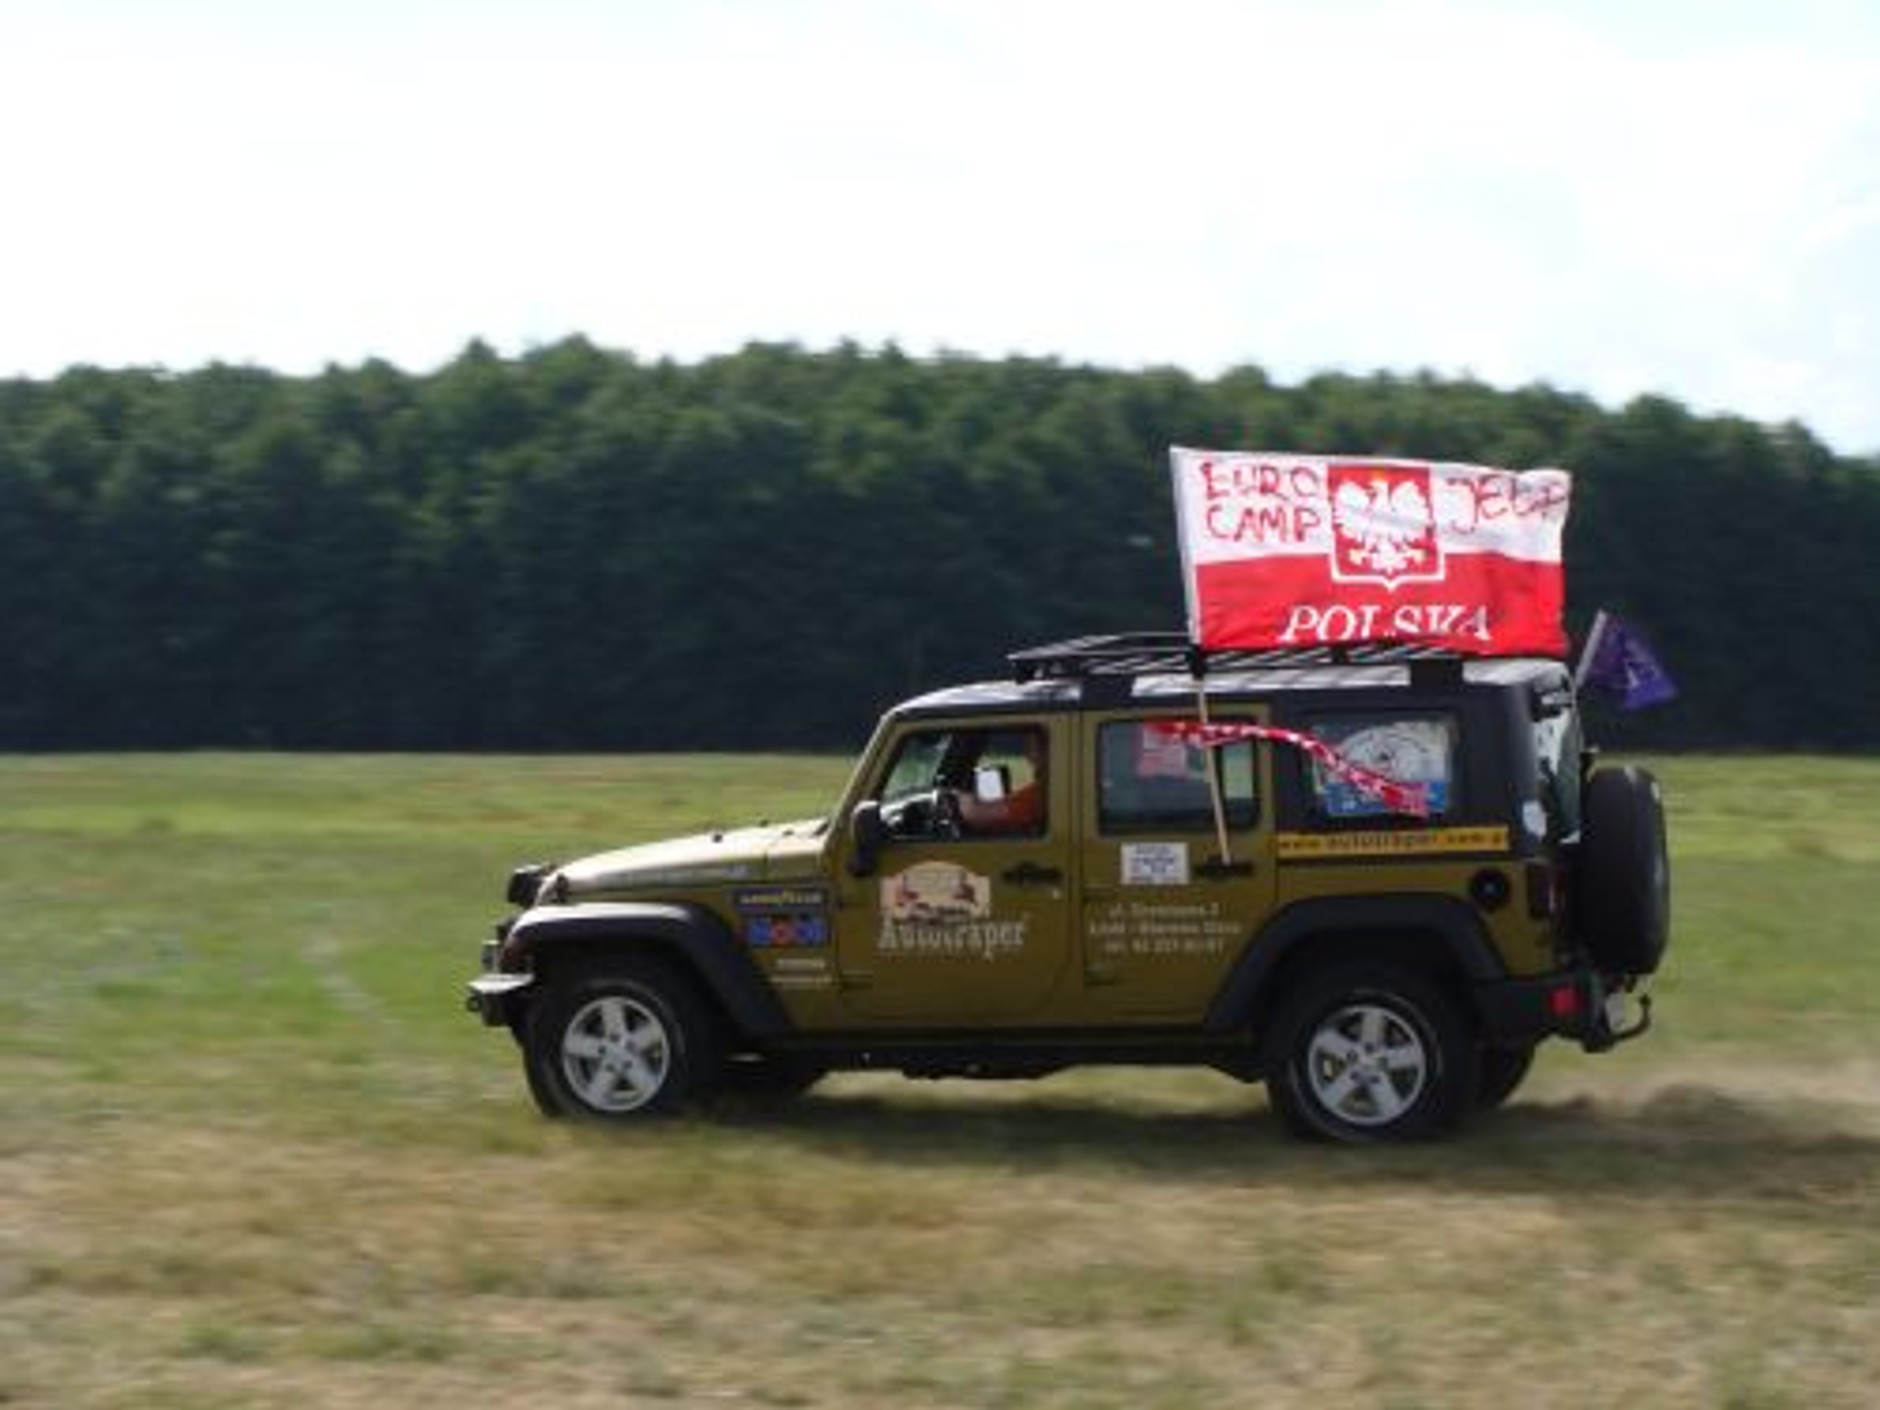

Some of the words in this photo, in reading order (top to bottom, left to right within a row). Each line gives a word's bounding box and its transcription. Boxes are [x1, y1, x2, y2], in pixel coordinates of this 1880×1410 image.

[1200, 462, 1320, 500] EURO
[1205, 505, 1322, 542] CAMP
[1278, 605, 1492, 642] POLSKA
